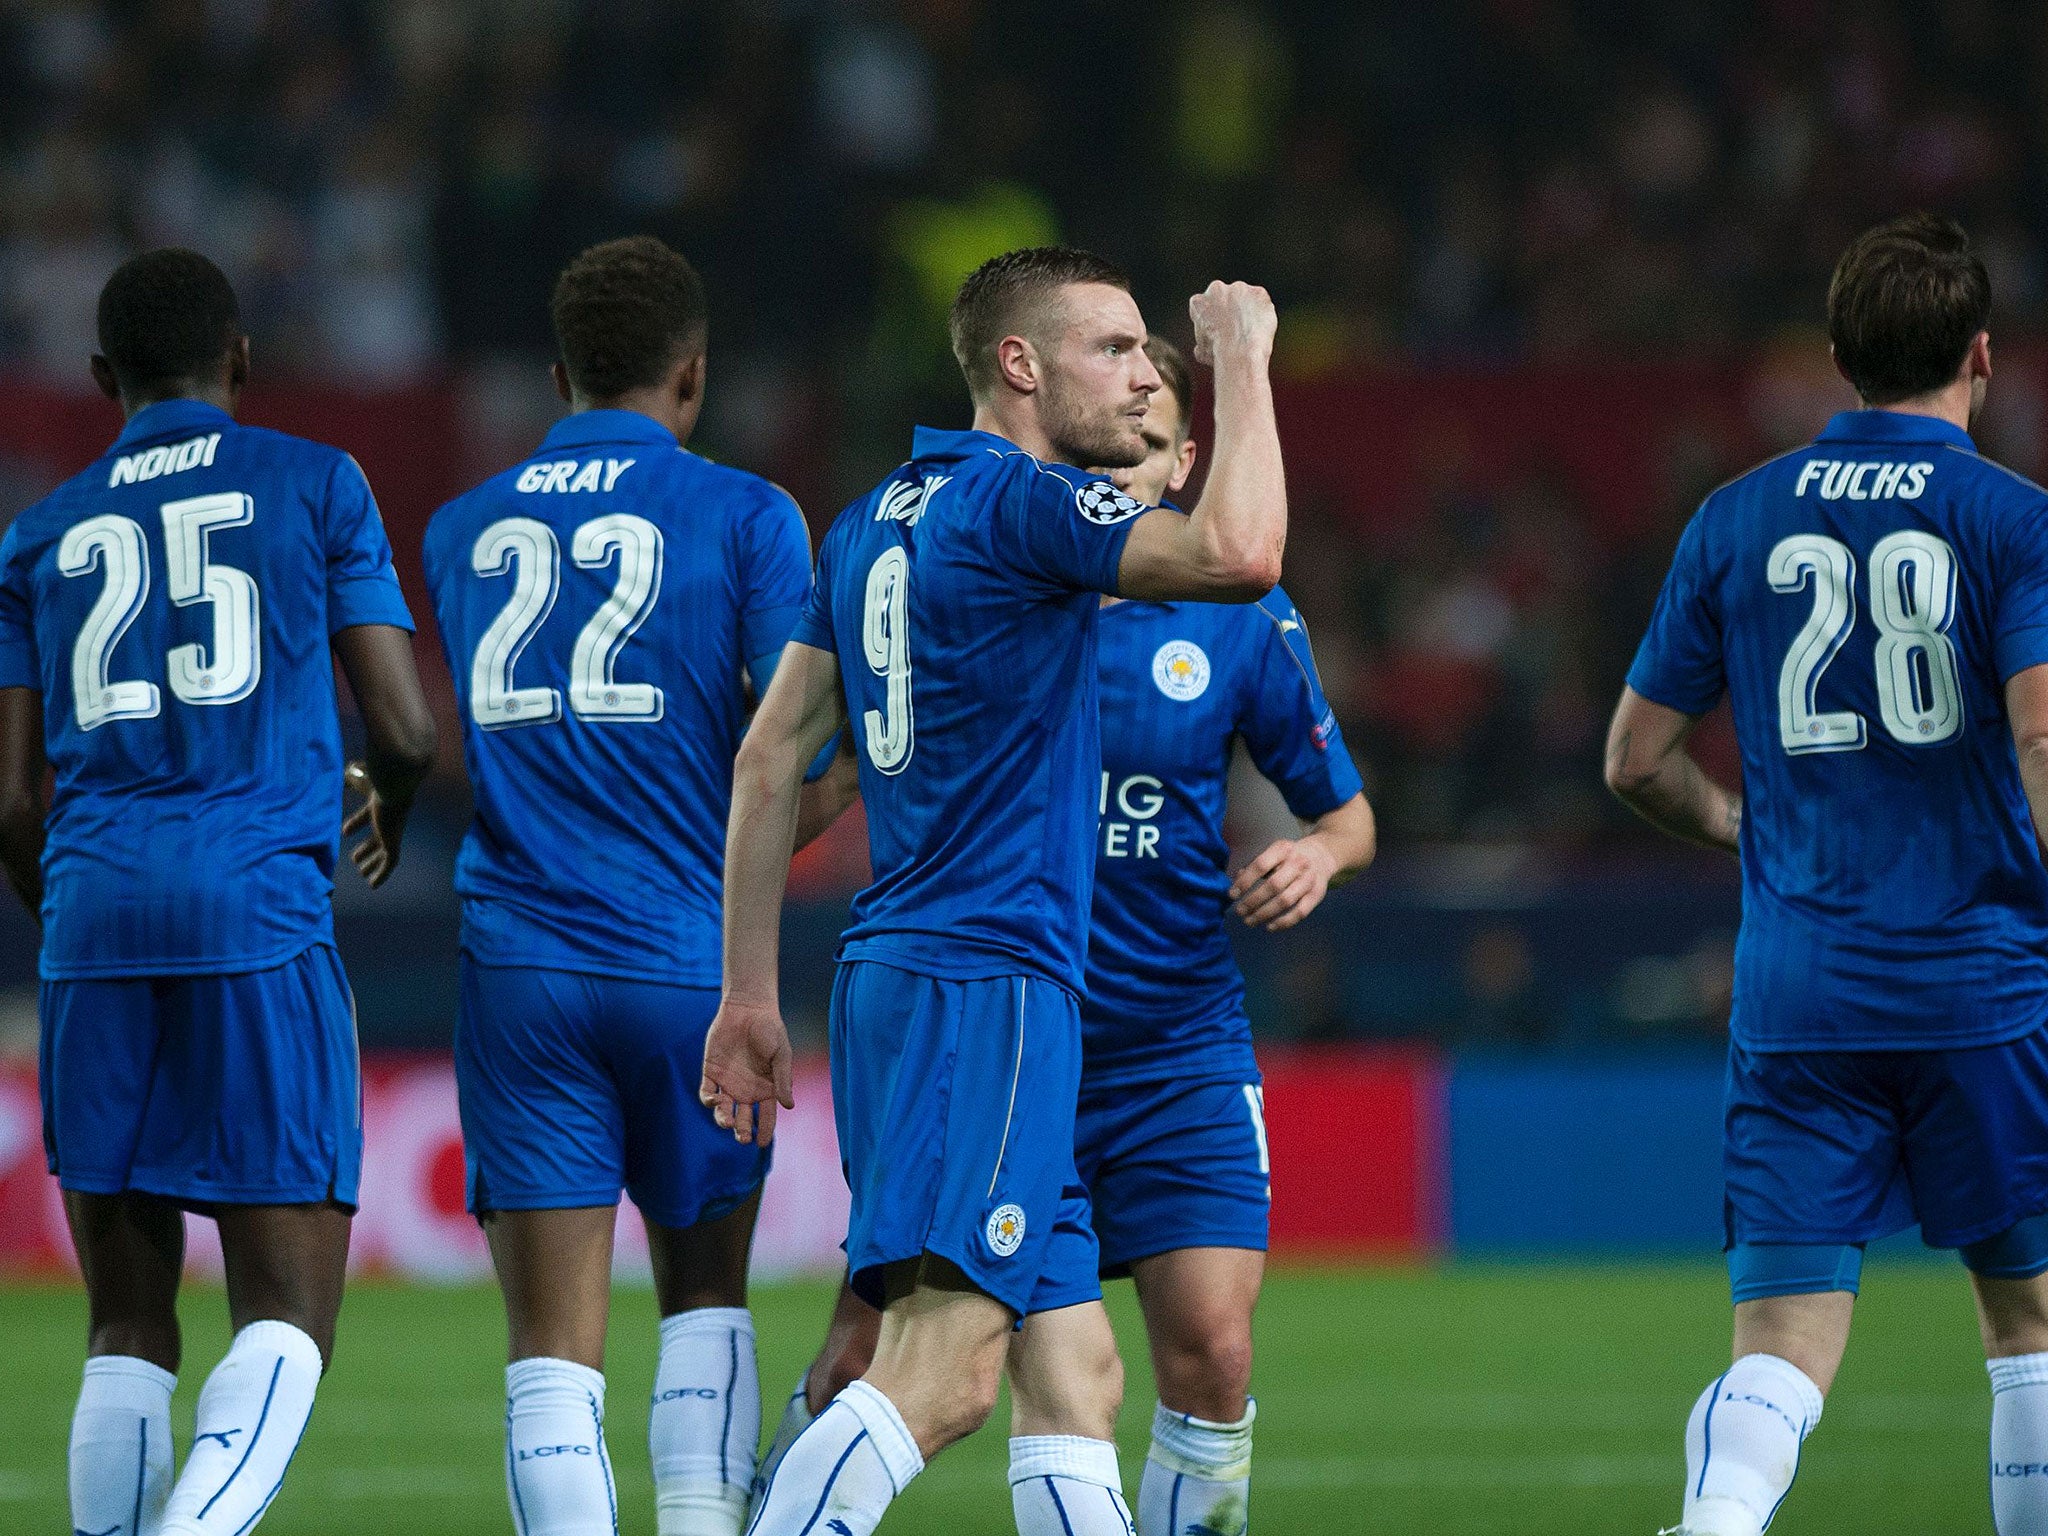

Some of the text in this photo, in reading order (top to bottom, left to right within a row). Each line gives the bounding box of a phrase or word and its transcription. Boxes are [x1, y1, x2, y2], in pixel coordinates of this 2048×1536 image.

[109, 433, 222, 489] NDIDI
[515, 458, 636, 494] GRAY
[1795, 459, 1935, 501] FUCHS
[57, 491, 262, 732] 25
[471, 513, 665, 732] 22
[863, 545, 915, 776] 9
[1767, 528, 1965, 756] 28
[519, 1444, 593, 1461] LCFC
